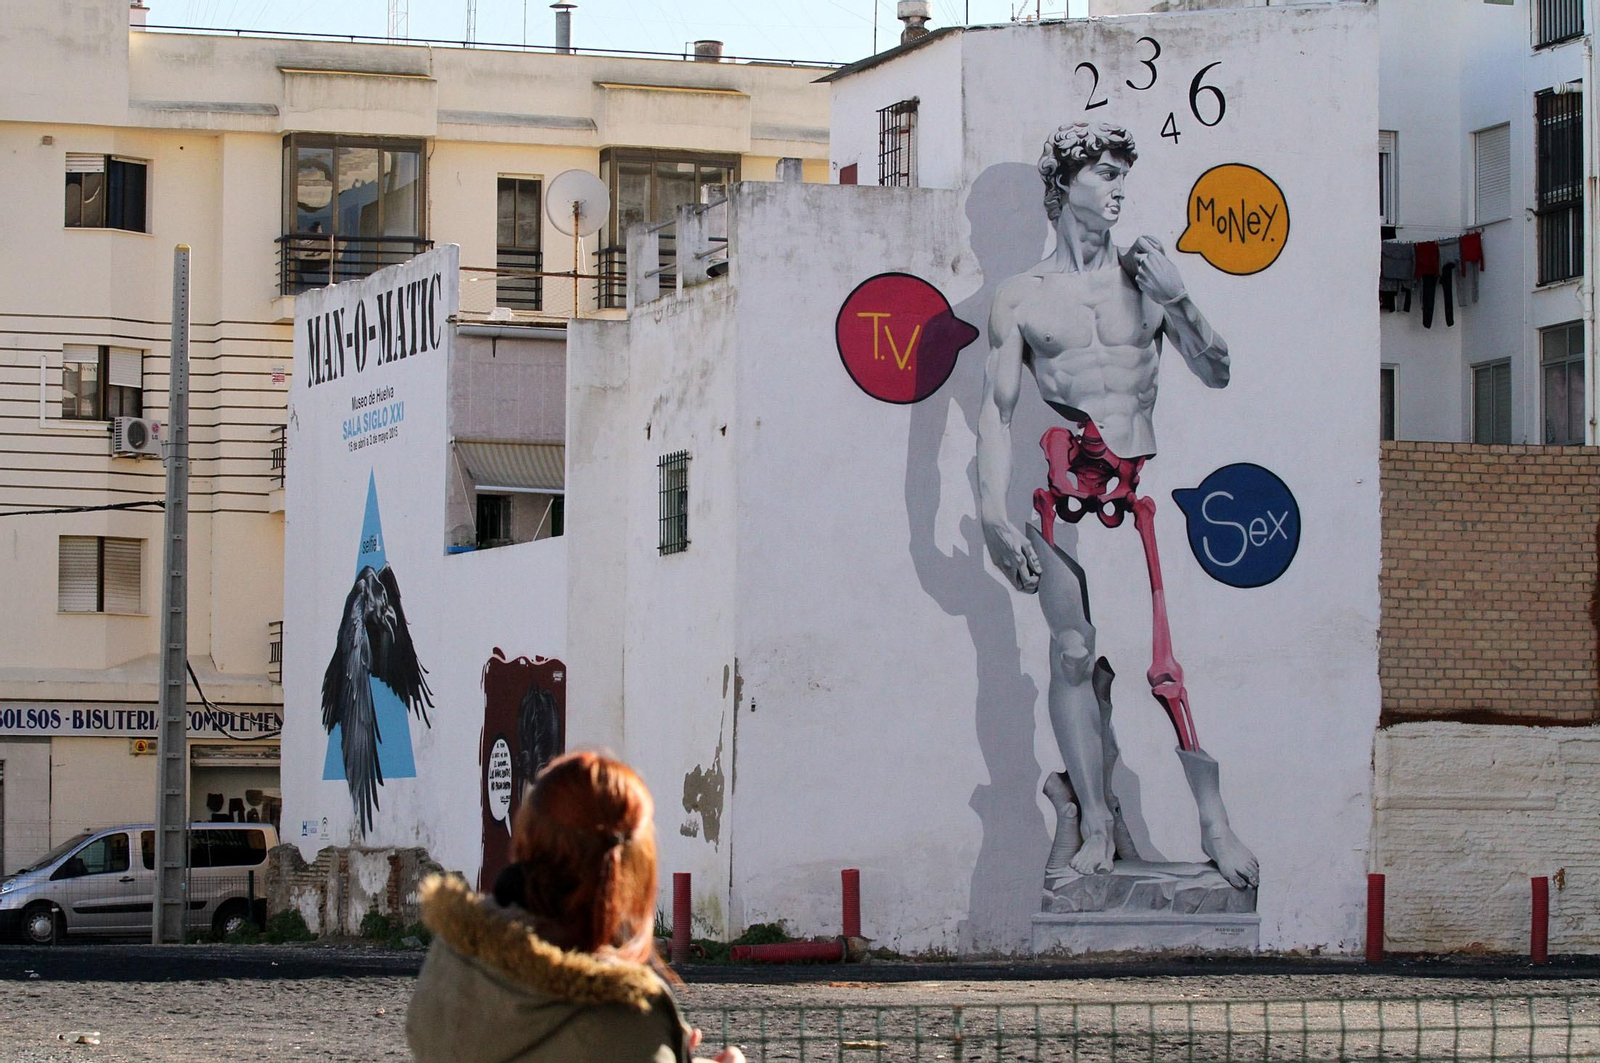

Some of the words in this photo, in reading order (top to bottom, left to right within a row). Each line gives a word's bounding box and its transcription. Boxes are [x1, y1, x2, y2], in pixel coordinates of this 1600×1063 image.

[1074, 62, 1108, 111] 2
[1126, 36, 1161, 91] 3
[1160, 111, 1181, 144] 4
[1189, 61, 1226, 127] 6
[307, 271, 442, 388] MAN-O-MATIC
[856, 312, 920, 371] T.V.
[352, 396, 367, 411] Museo
[368, 390, 375, 405] de
[376, 385, 394, 402] Huelva
[342, 415, 362, 440] SALA
[363, 406, 388, 432] SIGLO
[390, 401, 404, 424] XXI
[353, 440, 358, 451] de
[358, 436, 366, 450] abril
[373, 433, 377, 444] de
[378, 431, 389, 444] mayo
[389, 426, 398, 439] 2015
[0, 708, 61, 729] OLSOS
[72, 708, 159, 731] BISUTERI
